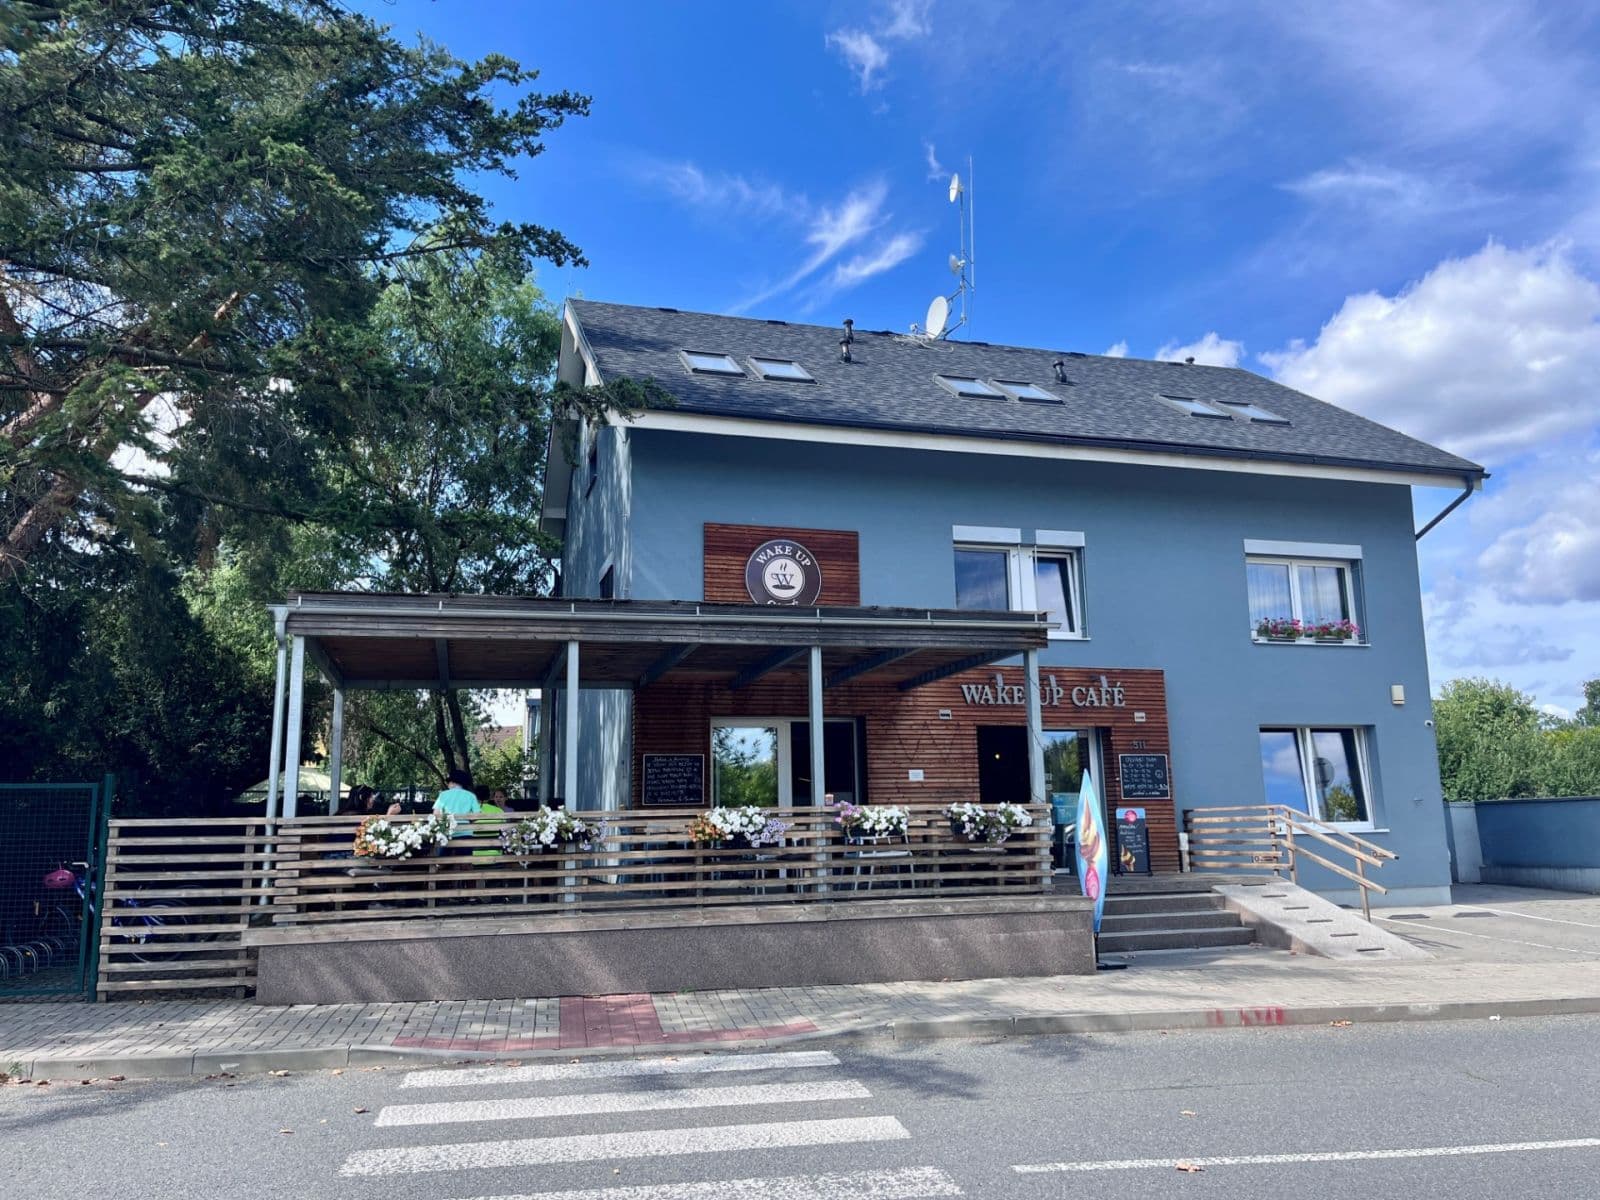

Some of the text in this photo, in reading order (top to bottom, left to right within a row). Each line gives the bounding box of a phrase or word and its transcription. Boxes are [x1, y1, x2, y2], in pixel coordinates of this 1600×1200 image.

[756, 545, 811, 566] WAKE UP
[961, 682, 1126, 707] WAKE UP CAFÉ
